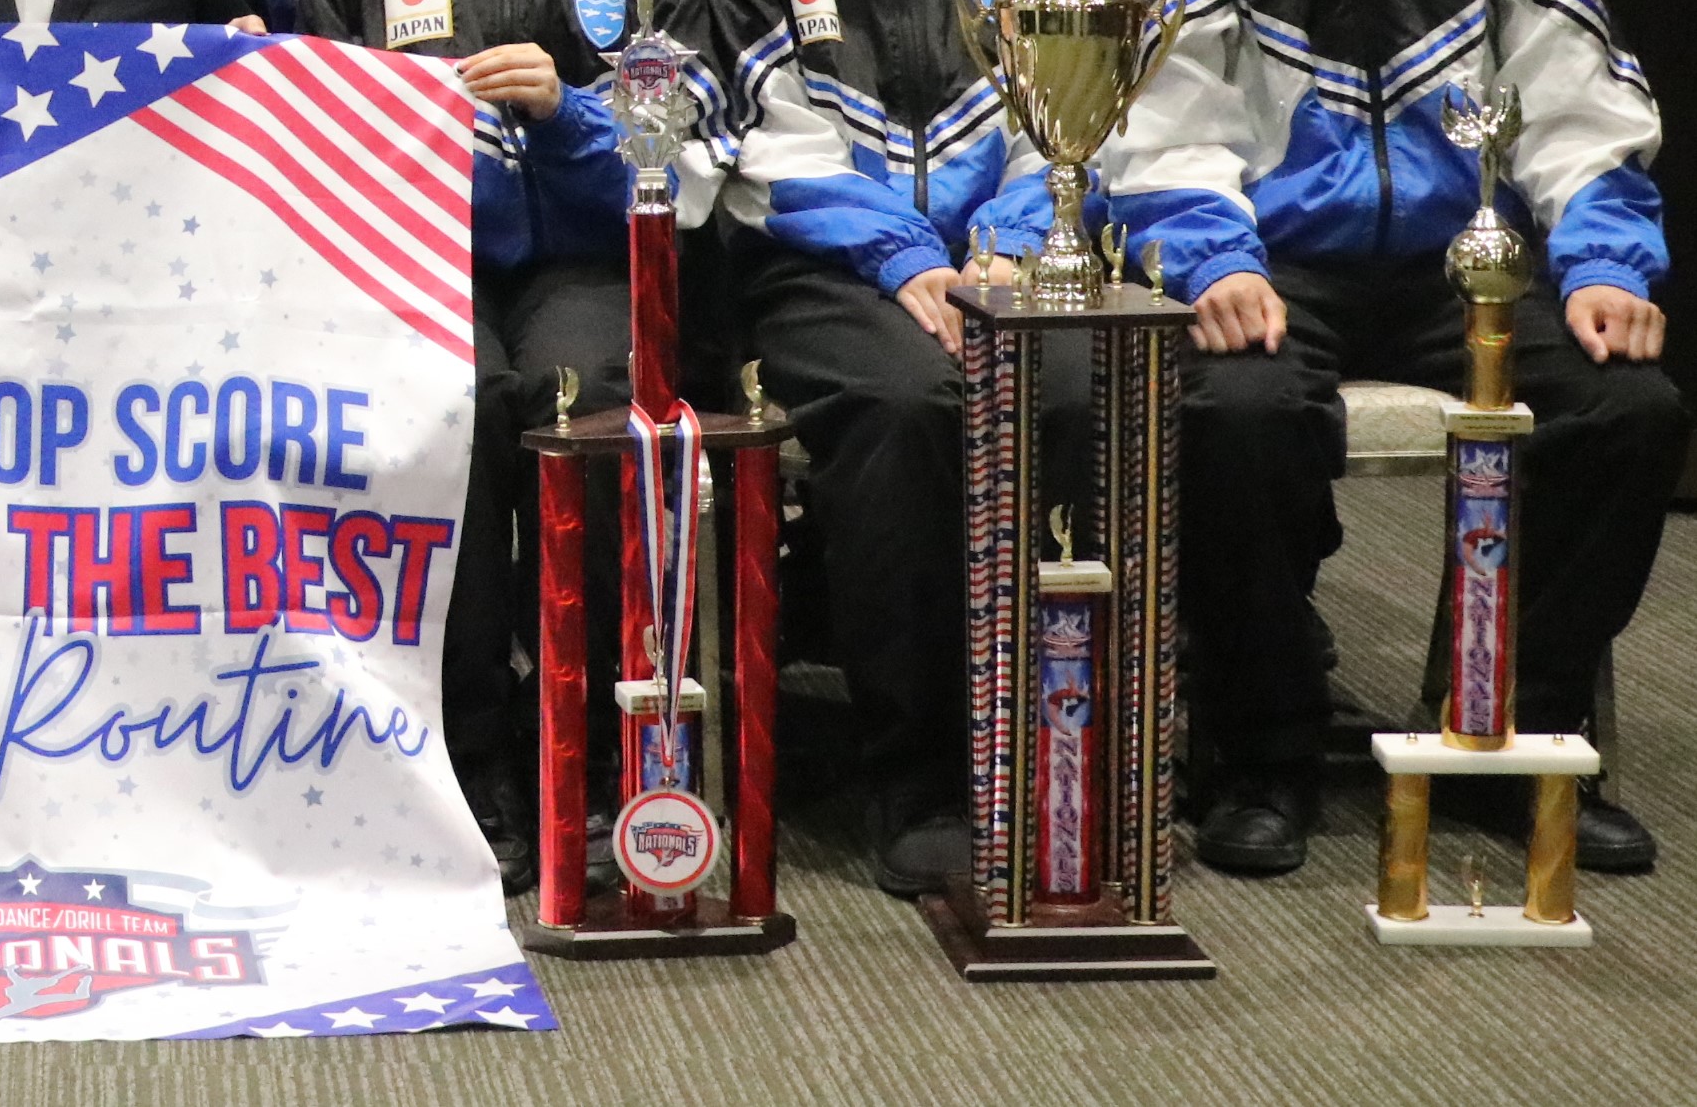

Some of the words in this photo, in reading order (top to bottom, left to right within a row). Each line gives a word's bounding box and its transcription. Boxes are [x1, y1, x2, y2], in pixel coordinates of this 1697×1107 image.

[390, 15, 445, 41] JAPAN
[797, 17, 839, 37] APAN
[112, 382, 371, 490] SCORE
[6, 501, 201, 637] THE
[220, 498, 454, 646] BEST
[638, 833, 696, 856] NATIONALS
[119, 914, 169, 935] TEAM
